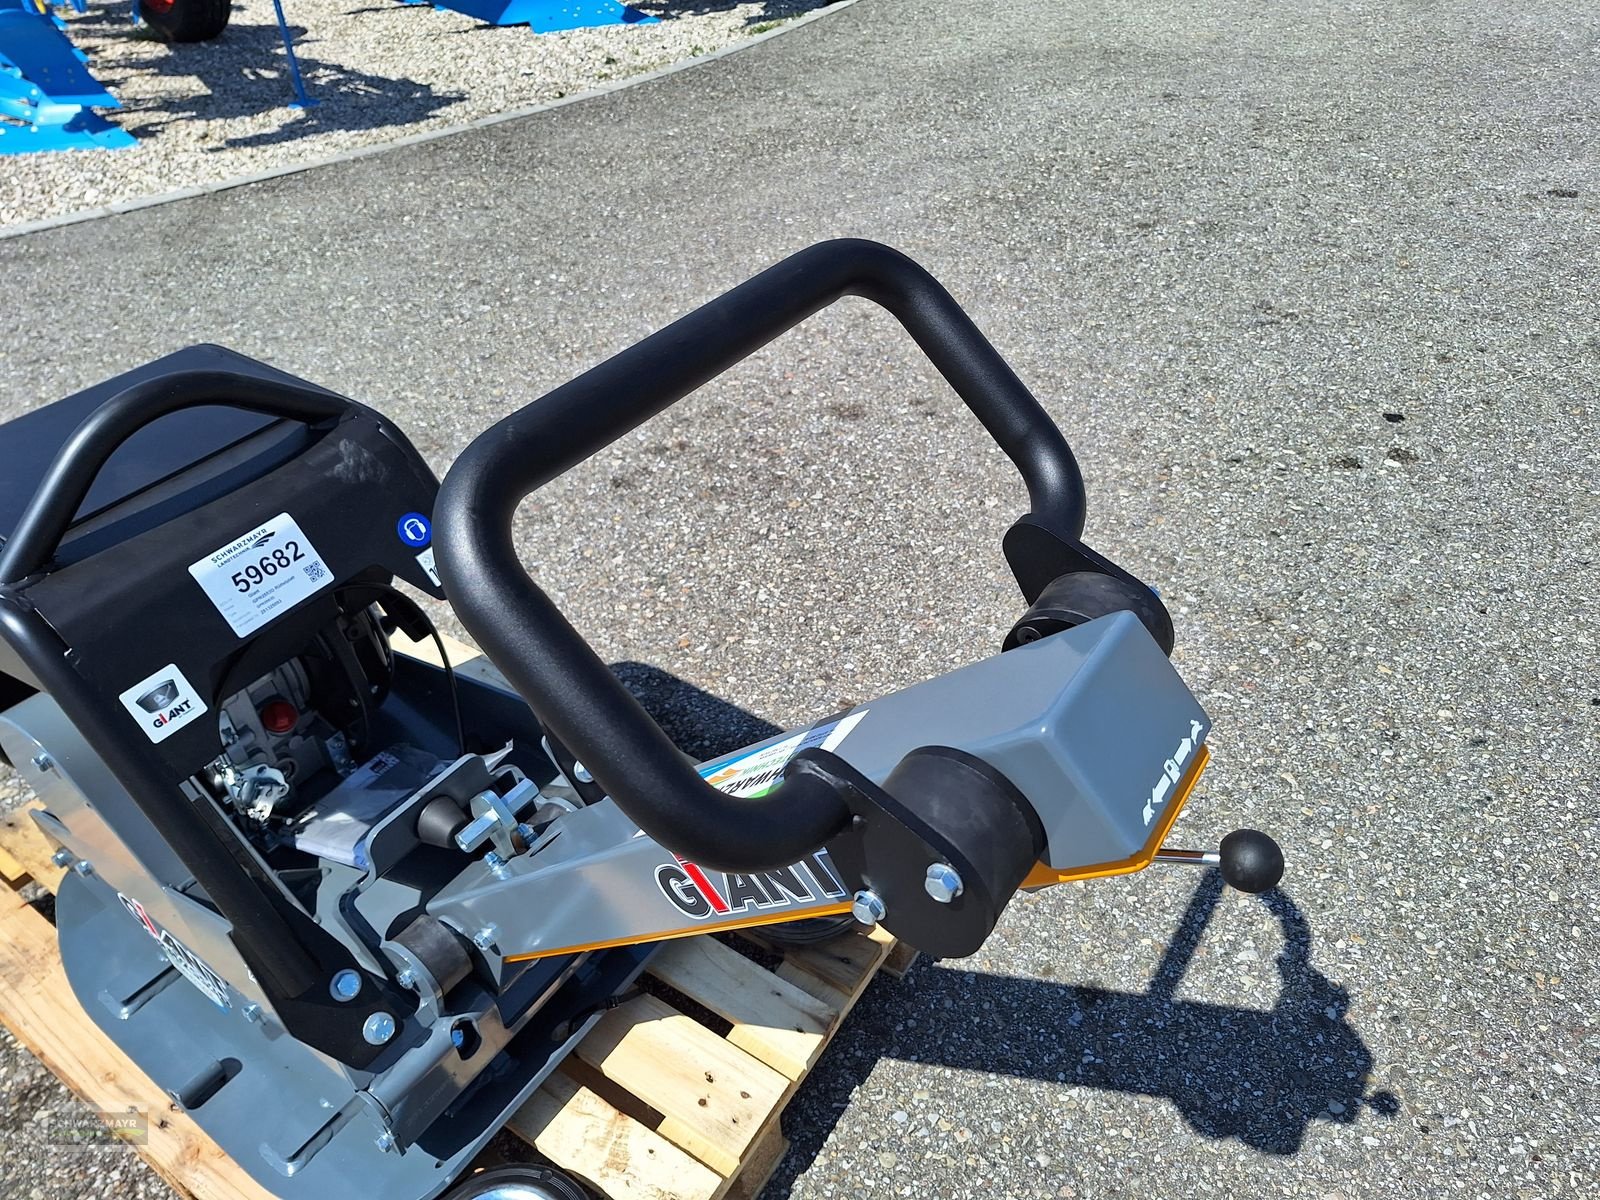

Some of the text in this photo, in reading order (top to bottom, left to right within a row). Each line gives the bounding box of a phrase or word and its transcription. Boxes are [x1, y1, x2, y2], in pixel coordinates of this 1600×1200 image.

[210, 528, 267, 563] SCHWARZMAYR
[217, 547, 250, 568] LANDTECHNIK
[231, 541, 305, 593] 59682
[153, 698, 191, 728] GIANT
